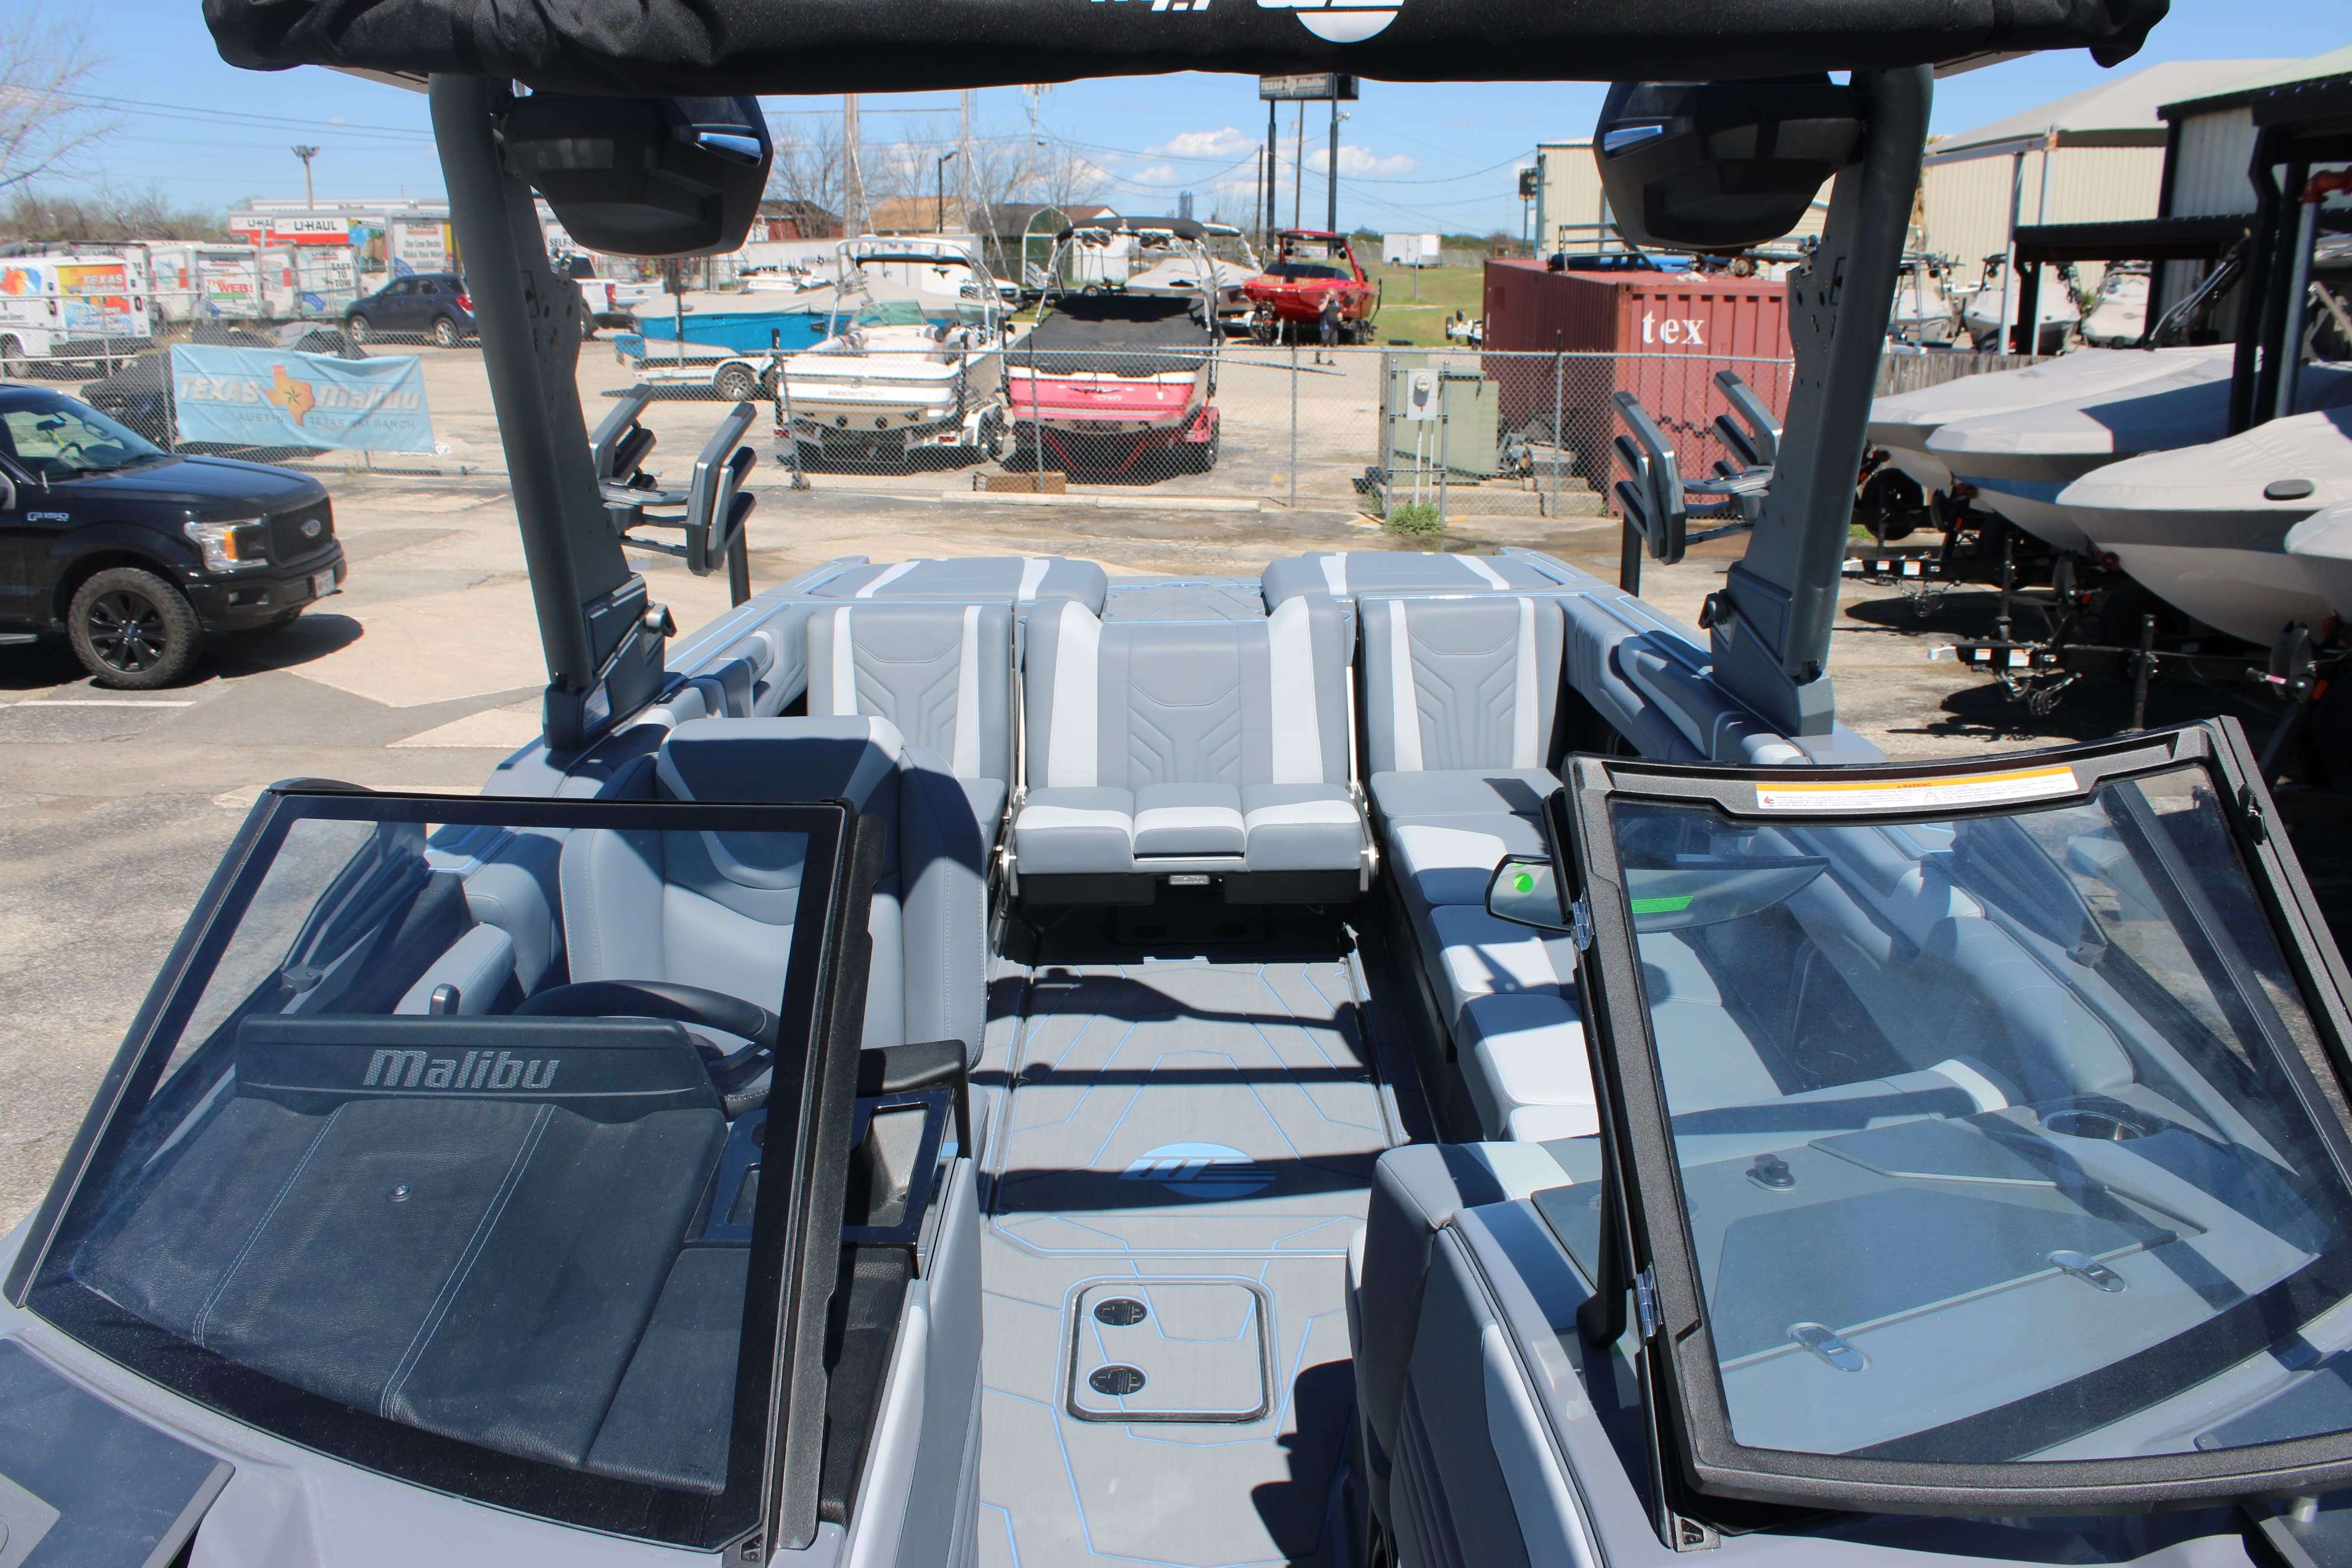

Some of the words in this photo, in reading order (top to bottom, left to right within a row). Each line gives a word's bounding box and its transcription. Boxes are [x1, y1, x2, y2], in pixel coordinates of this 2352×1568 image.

[294, 220, 337, 231] U-HAUL
[179, 377, 260, 404] TEXAS
[239, 413, 283, 424] AUSTIN
[309, 416, 345, 427] TEXAS
[374, 420, 416, 430] RANCH
[363, 1050, 560, 1089] Malibu
